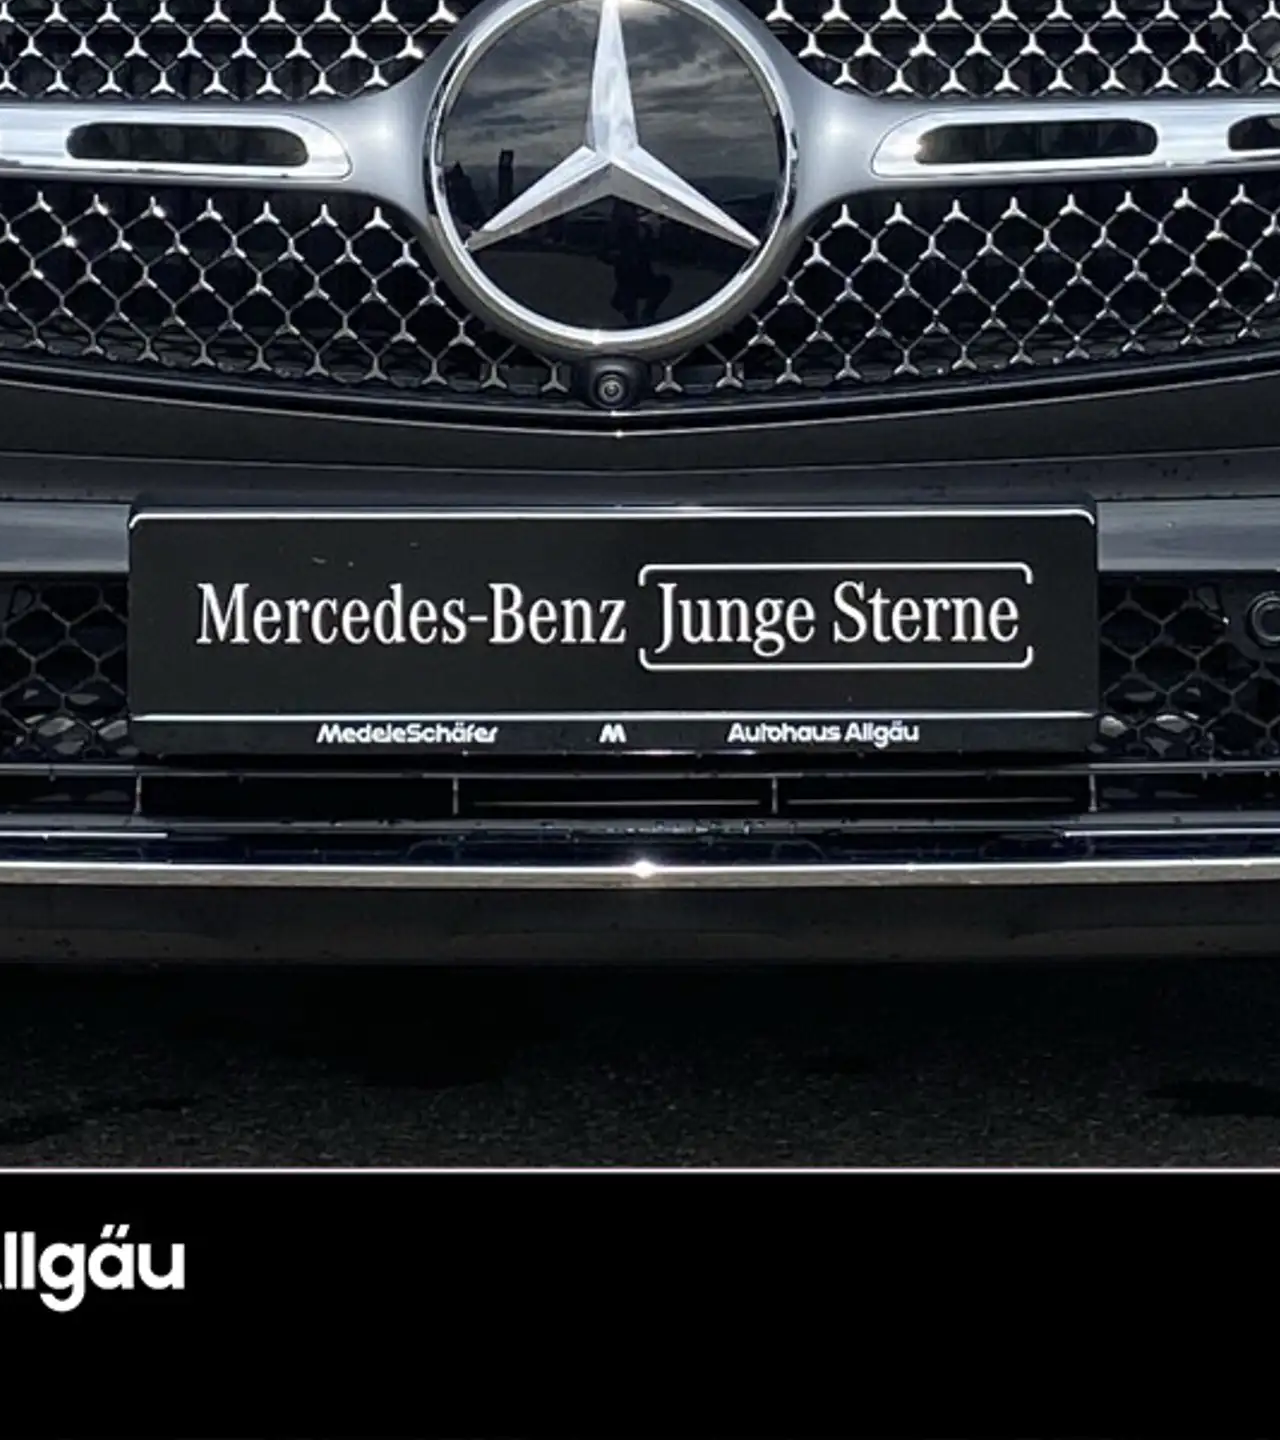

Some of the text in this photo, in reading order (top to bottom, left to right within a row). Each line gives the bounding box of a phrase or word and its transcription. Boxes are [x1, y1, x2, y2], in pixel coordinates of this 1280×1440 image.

[196, 579, 1019, 658] Mercedes-Benz Junge Sterne
[316, 721, 499, 744] MedeleSchäfer
[727, 720, 920, 749] Autohaus Allgäu
